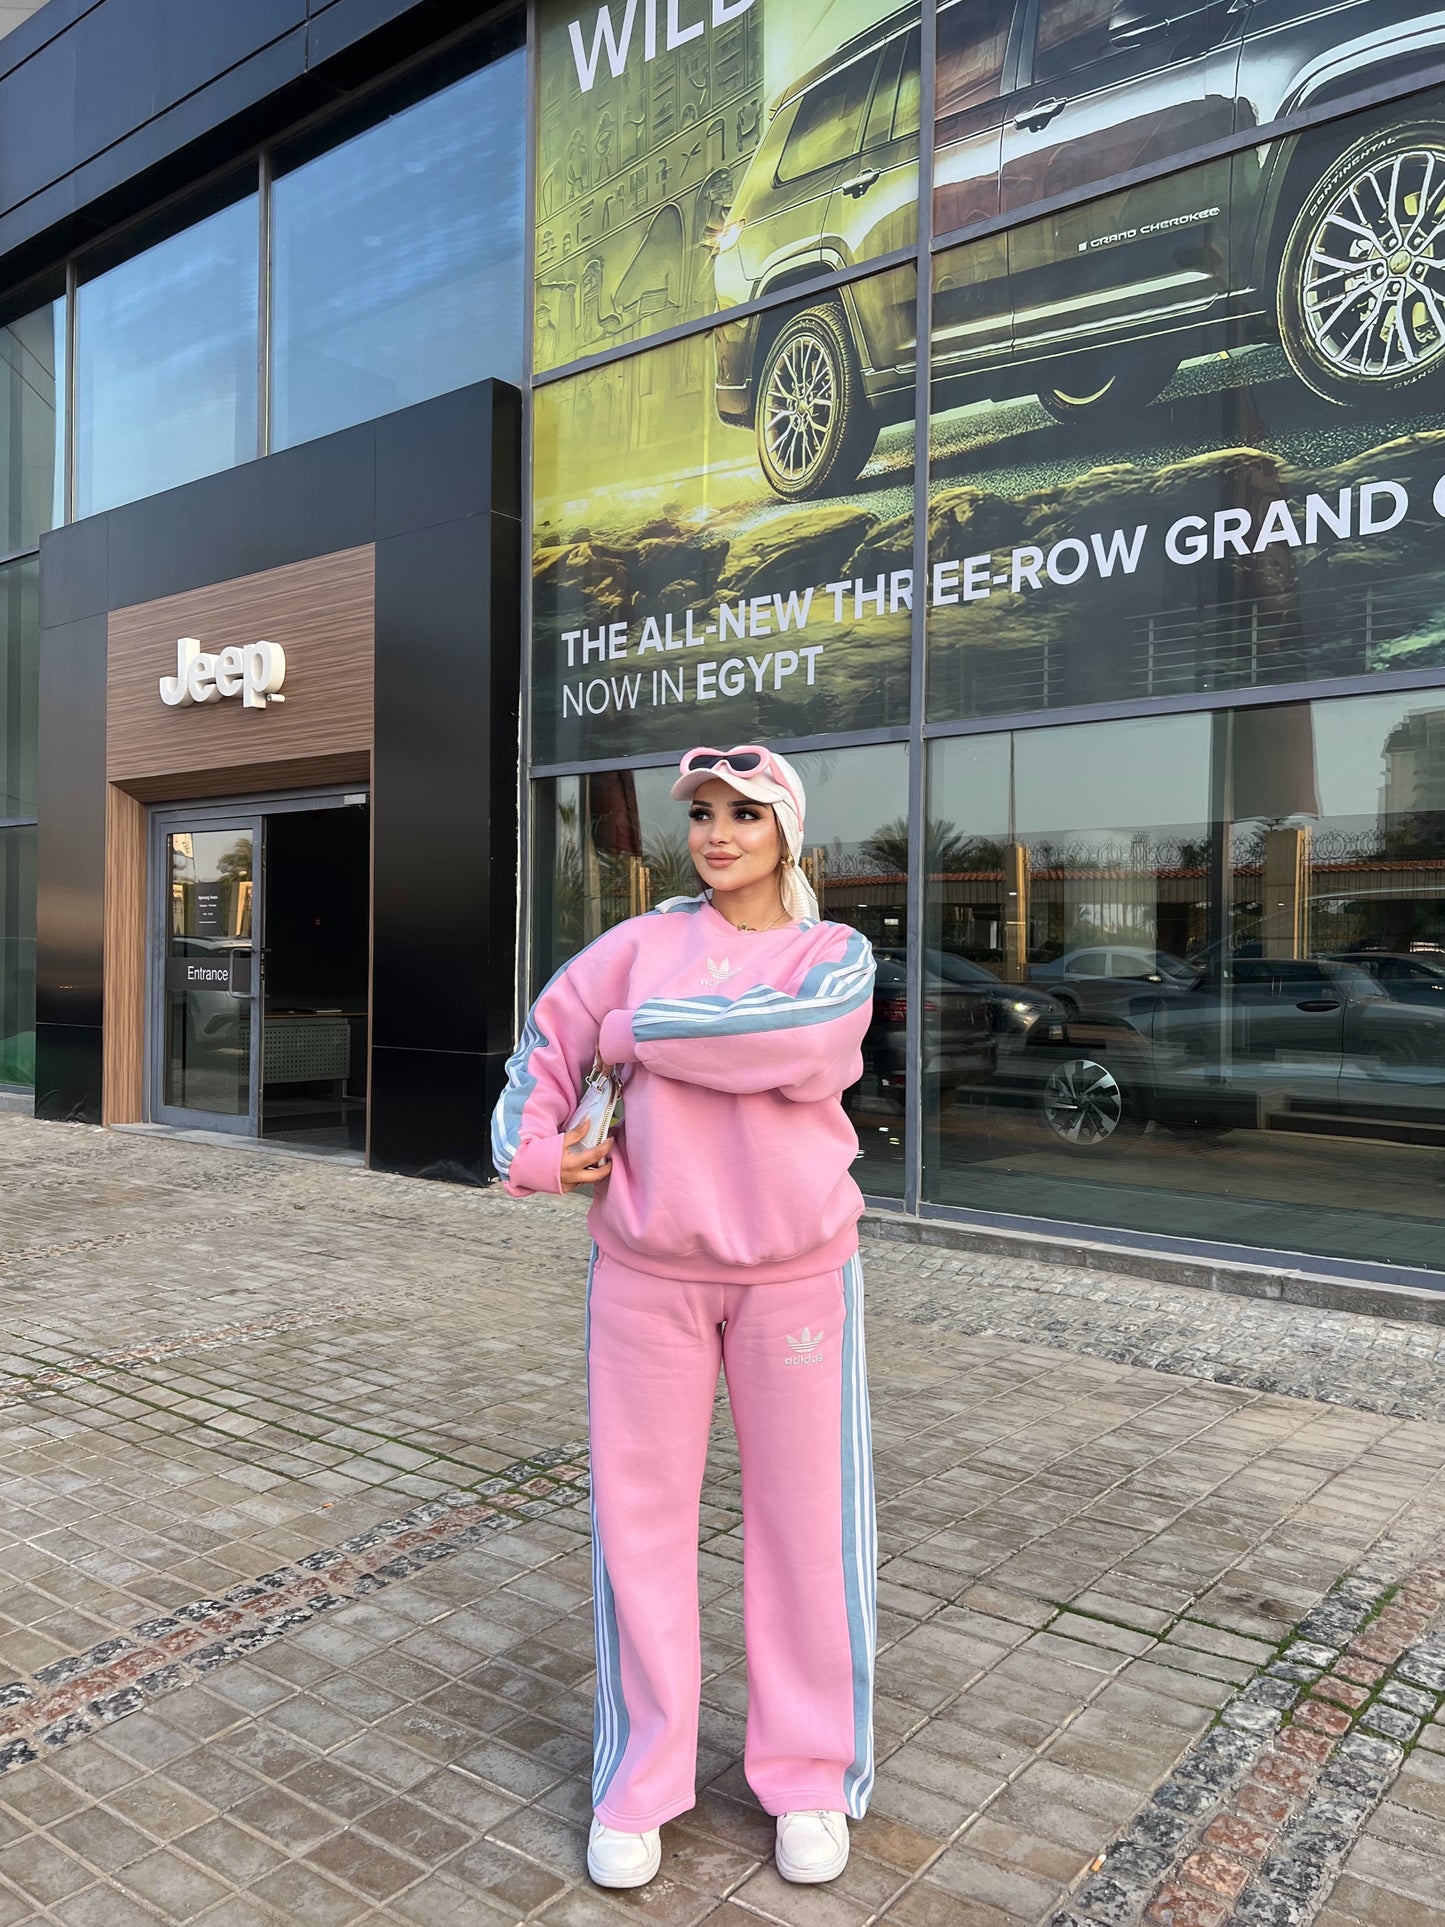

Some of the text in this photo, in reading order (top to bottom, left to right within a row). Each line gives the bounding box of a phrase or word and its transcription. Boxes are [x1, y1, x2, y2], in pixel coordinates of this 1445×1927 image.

[1090, 206, 1221, 248] GRAND CHEROKEE
[561, 621, 628, 668] THE
[637, 586, 815, 656] ALL-NEW
[825, 524, 1149, 623] THREE-ROW
[1165, 479, 1410, 566] GRAND
[159, 637, 286, 709] Jeep
[562, 644, 824, 719] NOW IN EGYPT
[187, 965, 229, 981] Entrance
[784, 1353, 824, 1367] adidas
